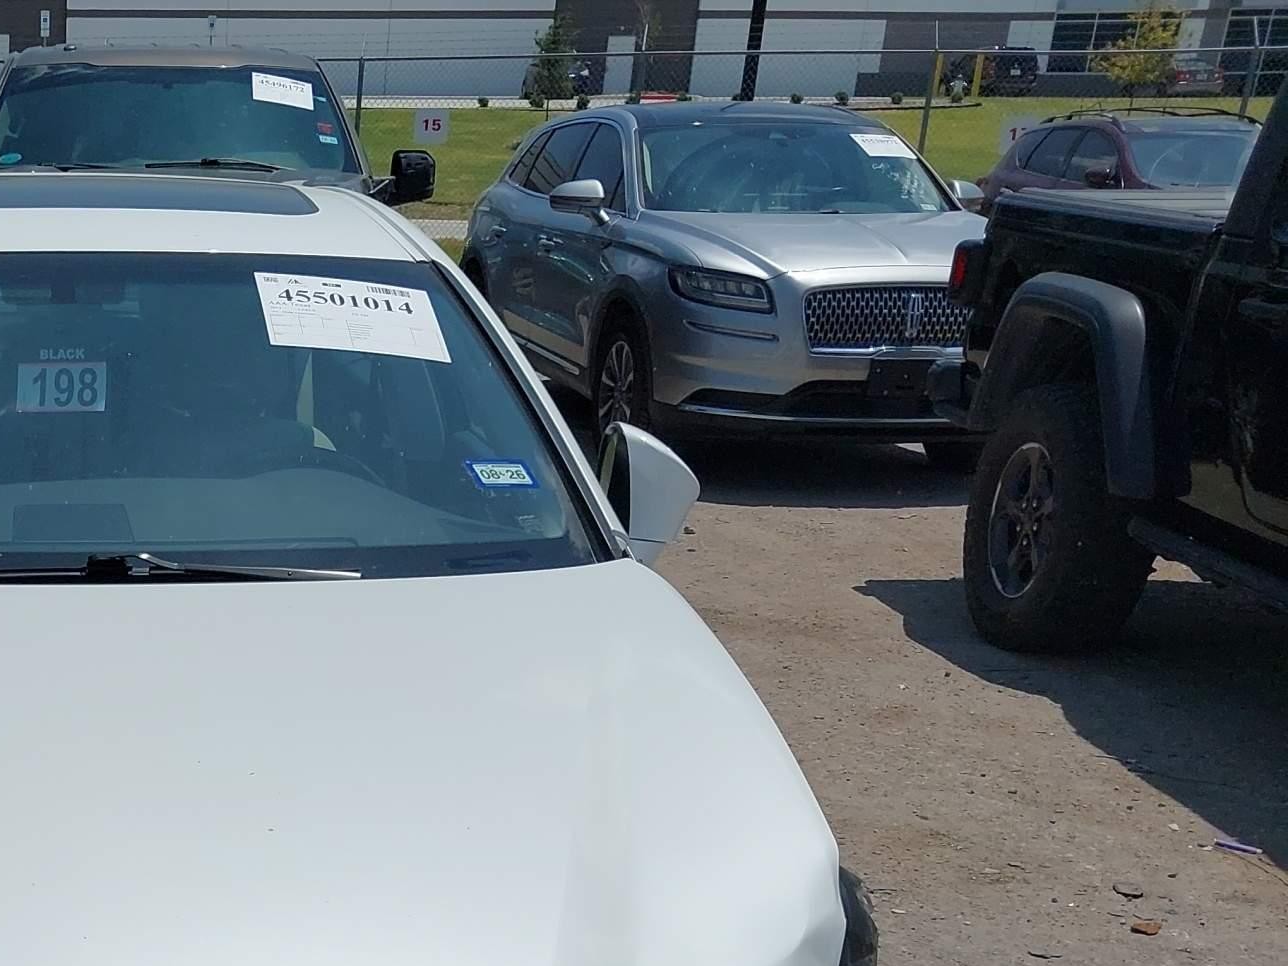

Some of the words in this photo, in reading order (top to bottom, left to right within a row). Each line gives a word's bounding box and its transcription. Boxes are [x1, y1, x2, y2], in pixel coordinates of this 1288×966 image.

[423, 118, 441, 131] 15
[278, 288, 414, 315] 45501014
[39, 348, 86, 360] BLACK
[32, 367, 98, 407] 198
